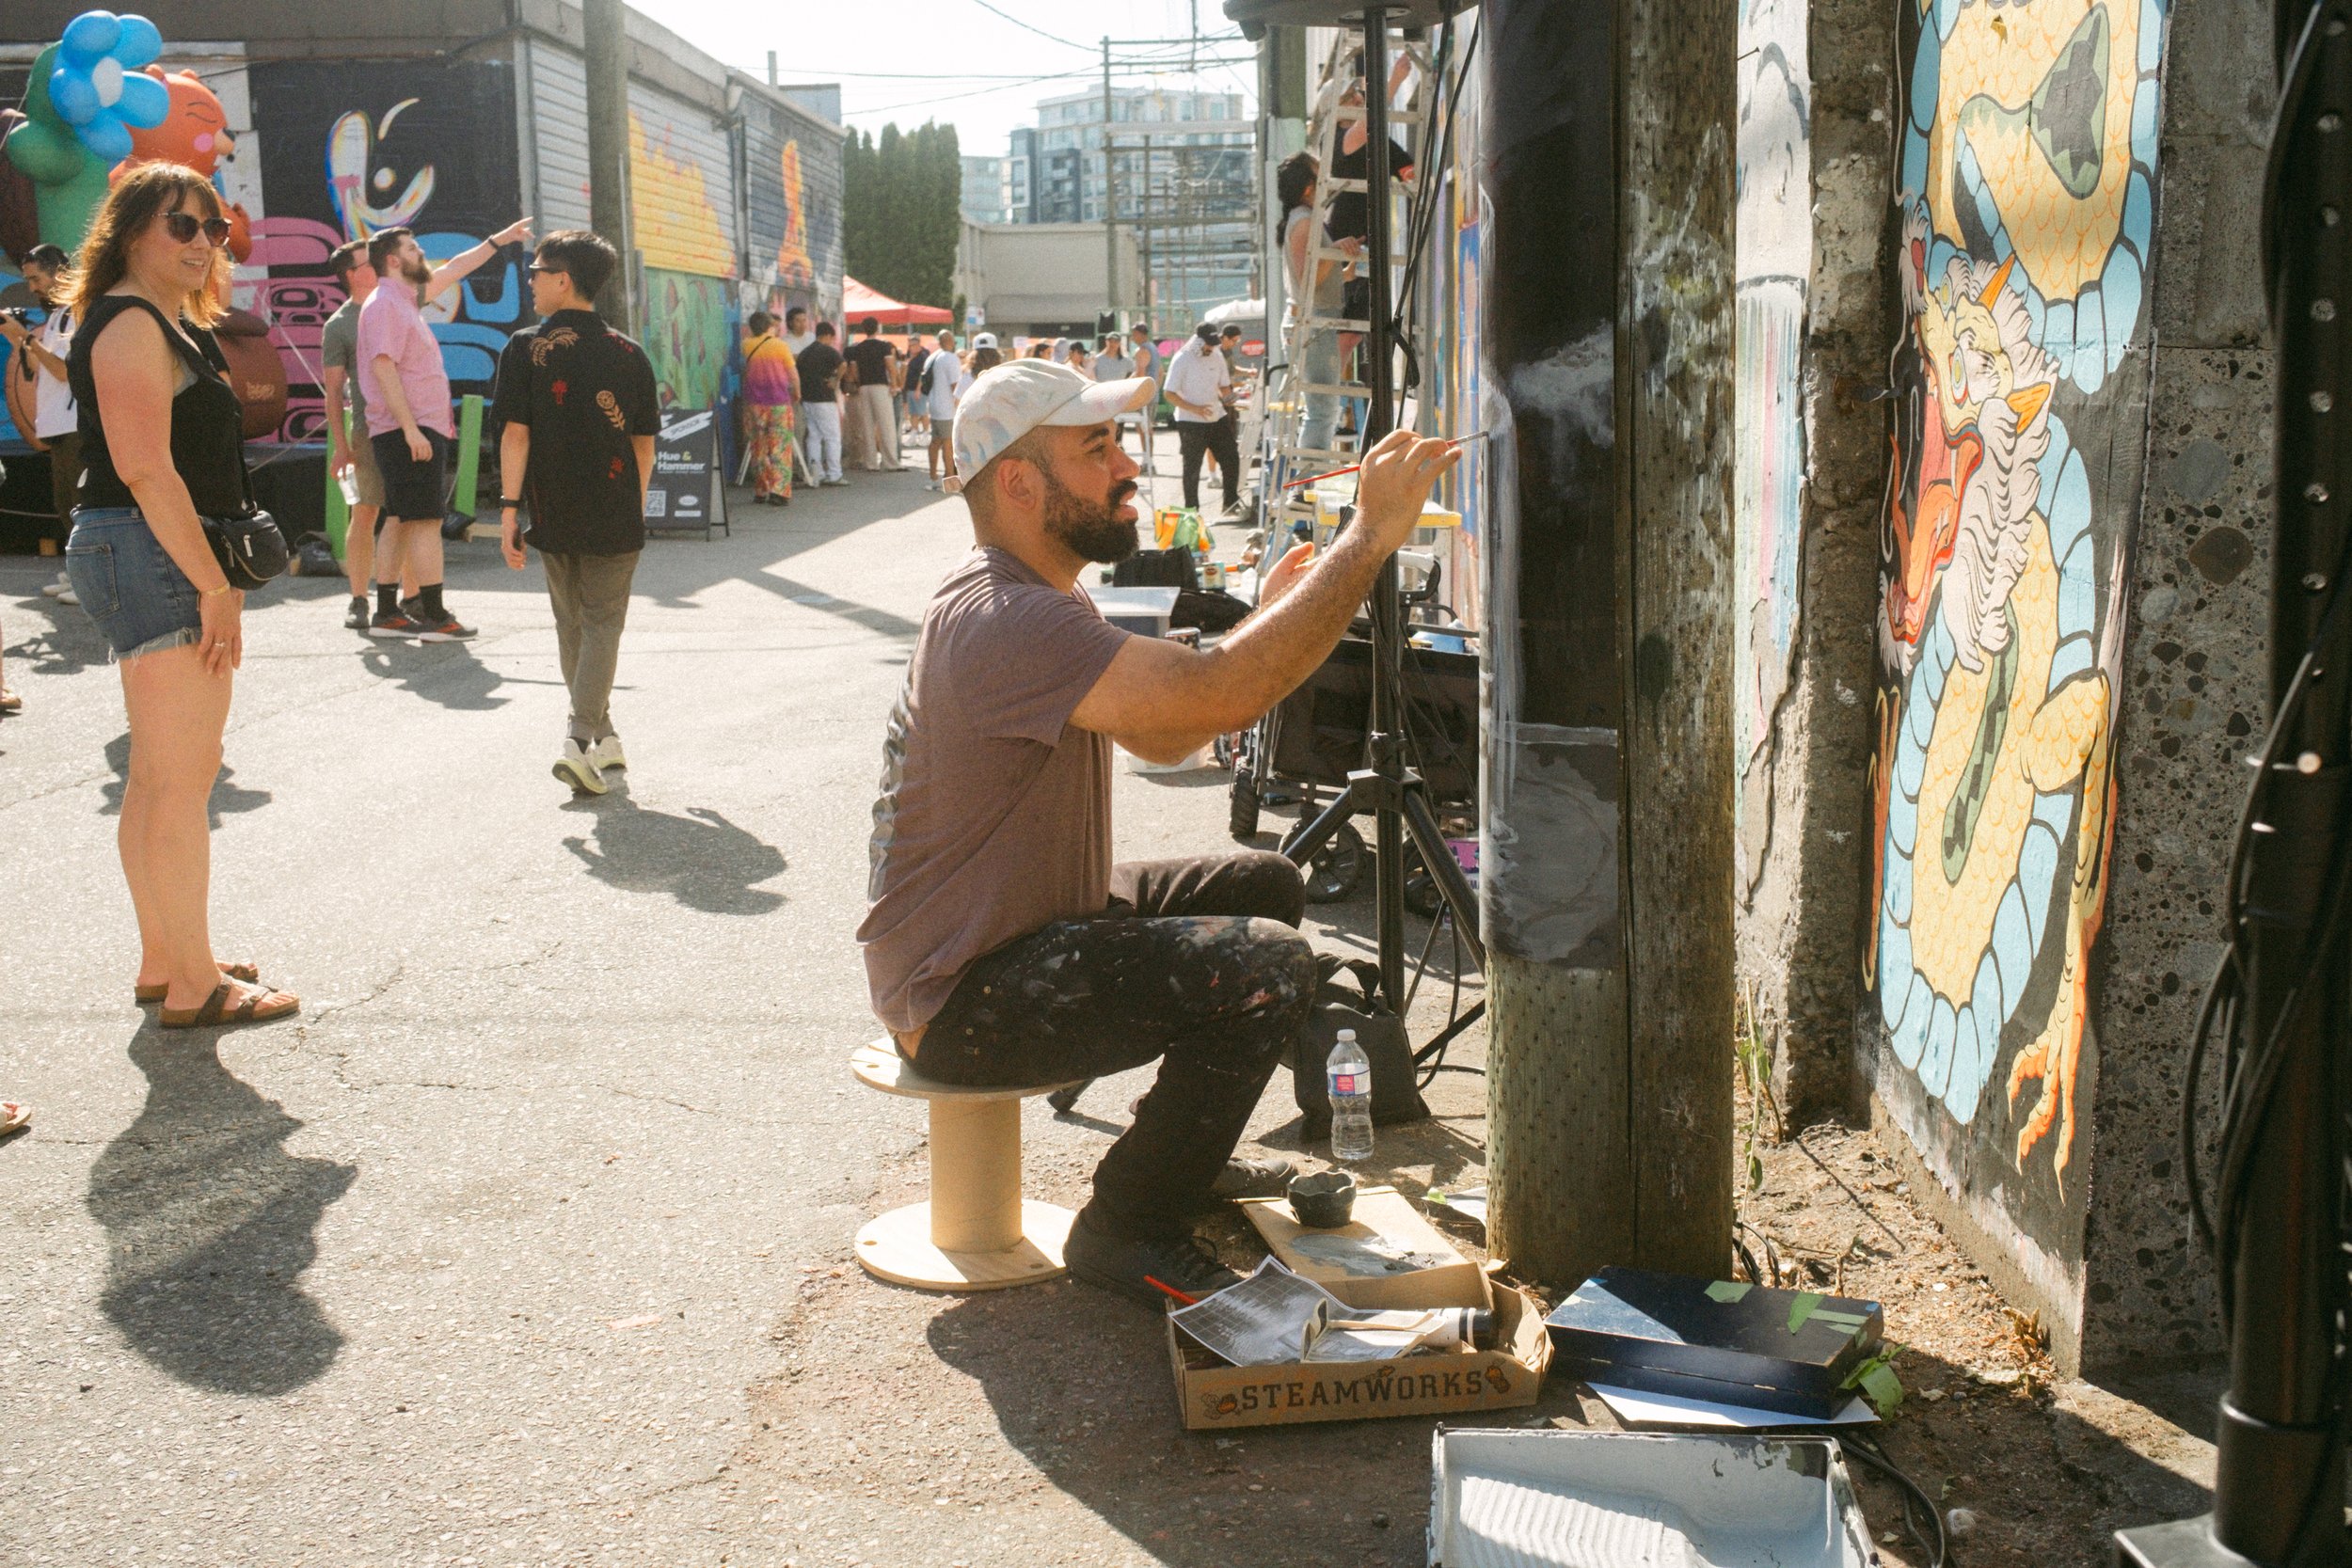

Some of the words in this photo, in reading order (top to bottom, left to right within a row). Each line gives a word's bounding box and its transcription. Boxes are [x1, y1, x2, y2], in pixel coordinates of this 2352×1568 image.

[658, 451, 680, 461] Hue
[682, 451, 691, 461] &
[657, 461, 706, 470] Hammer
[1241, 1370, 1483, 1411] STEAMWORKS
